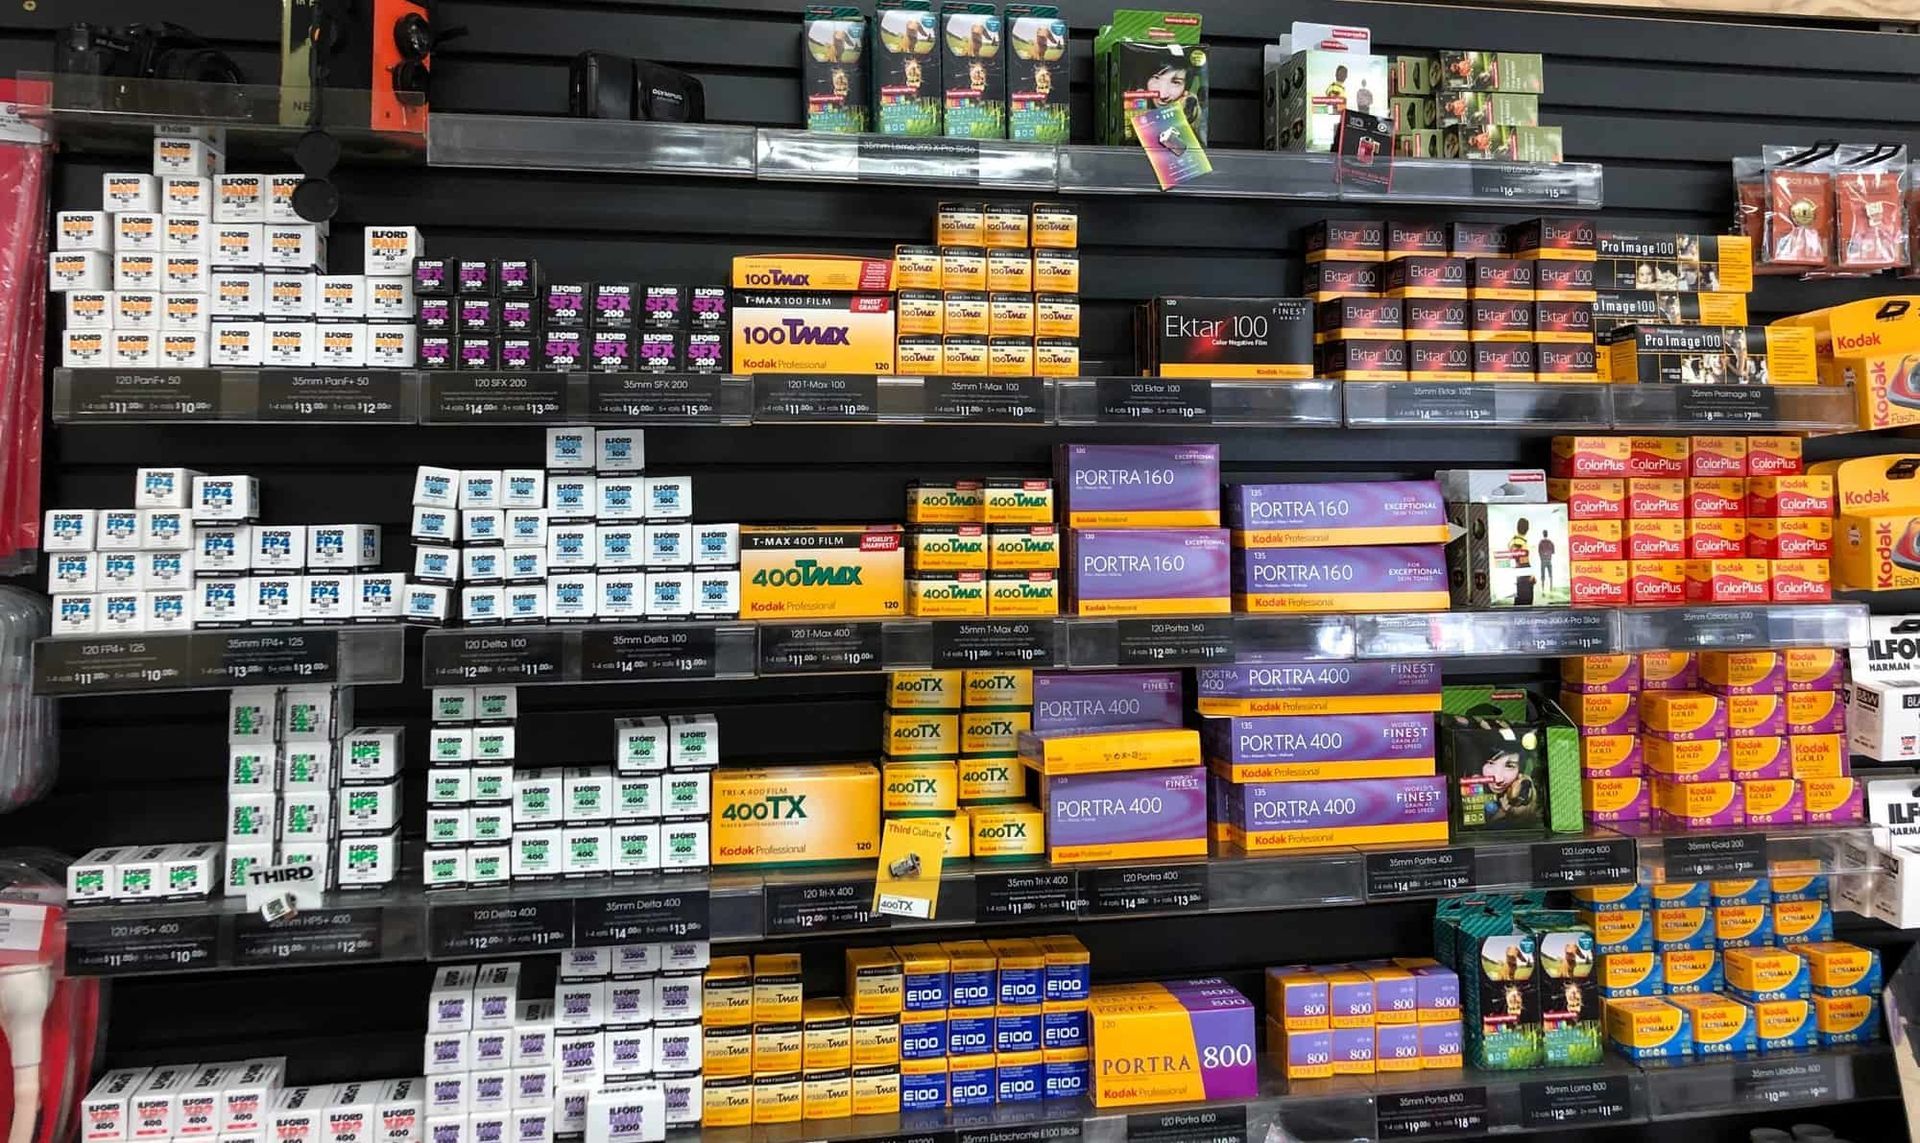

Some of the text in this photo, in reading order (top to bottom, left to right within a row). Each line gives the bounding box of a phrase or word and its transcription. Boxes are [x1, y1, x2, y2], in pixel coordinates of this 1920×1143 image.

[372, 230, 407, 239] ILFORD
[1331, 229, 1379, 242] Ektar 100
[1656, 243, 1674, 254] 100
[552, 285, 582, 293] ILFORD
[548, 296, 583, 310] SFX
[745, 297, 831, 305] T-MAX 100 FILM
[1166, 316, 1268, 338] Ektar 100
[1702, 336, 1720, 346] 100
[1837, 332, 1882, 350] Kodak
[743, 359, 889, 370] Kodak Professional 120
[292, 378, 321, 386] 35mm
[356, 378, 369, 386] 50
[475, 379, 526, 387] 120 SFX 200
[624, 381, 688, 389] 35mm SFX 200
[802, 381, 828, 389] T-Max
[831, 381, 845, 389] 100
[952, 383, 1019, 391] 35mm T-Max 100
[1871, 360, 1888, 426] Kodak
[1076, 470, 1174, 485] PORTRA 160
[203, 488, 232, 499] FP4
[1845, 489, 1890, 504] Kodak
[1251, 501, 1348, 517] PORTRA 160
[1385, 502, 1436, 511] EXCEPTIONAL
[753, 537, 843, 546] T-MAX 400 FILM
[1253, 534, 1329, 544] Kodak Professional
[1695, 540, 1739, 552] ColorPlus
[1878, 522, 1893, 588] Kodak
[1085, 556, 1184, 572] PORTRA 160
[1254, 565, 1353, 580] PORTRA 160
[1389, 568, 1442, 576] EXCEPTIONAL
[1716, 582, 1761, 594] ColorPlus
[751, 601, 898, 611] Kodak Professional 120
[791, 629, 850, 638] 120 T-Max 400
[1152, 624, 1164, 633] 120
[1166, 624, 1188, 632] Portra
[228, 638, 303, 649] 35mm FP4+ 125
[465, 639, 526, 648] 120 Delta 100
[613, 634, 687, 644] 35mm Delta 100
[1390, 664, 1435, 674] FINEST
[1869, 663, 1910, 671] HARMAN
[1249, 668, 1350, 686] PORTRA 400
[896, 678, 942, 692] 400TX
[1383, 727, 1427, 738] FINEST
[1241, 734, 1342, 751] PORTRA 400
[1795, 743, 1828, 754] Kodak
[1397, 792, 1440, 802] FINEST
[722, 795, 806, 820] 400TX
[1057, 797, 1162, 817] PORTRA 400
[1254, 799, 1355, 818] PORTRA 400
[889, 824, 942, 838] Third Culture
[978, 824, 1027, 838] 400TX
[1255, 834, 1334, 845] Kodak Professional
[720, 842, 871, 856] Kodak Professional 120
[1390, 856, 1452, 866] 35mm Portra 400
[249, 867, 312, 885] THIRD
[1008, 876, 1068, 887] 35mm Tri-X 400
[1124, 871, 1178, 882] 120 Portra 400
[804, 887, 853, 898] 120 Tri-X 400
[606, 898, 680, 911] 35mm Delta 400
[881, 900, 913, 910] 400TX
[1047, 980, 1081, 991] E100
[908, 989, 941, 1001] E100
[1435, 997, 1456, 1007] 800
[1102, 1020, 1116, 1028] 120
[562, 1042, 594, 1051] ILFORD
[1203, 1044, 1251, 1068] 800
[1103, 1057, 1191, 1075] PORTRA
[1104, 1086, 1188, 1099] Kodak Professional
[1400, 1097, 1422, 1106] 35mm
[1424, 1095, 1446, 1104] Portra
[610, 1106, 643, 1114] ILFORD
